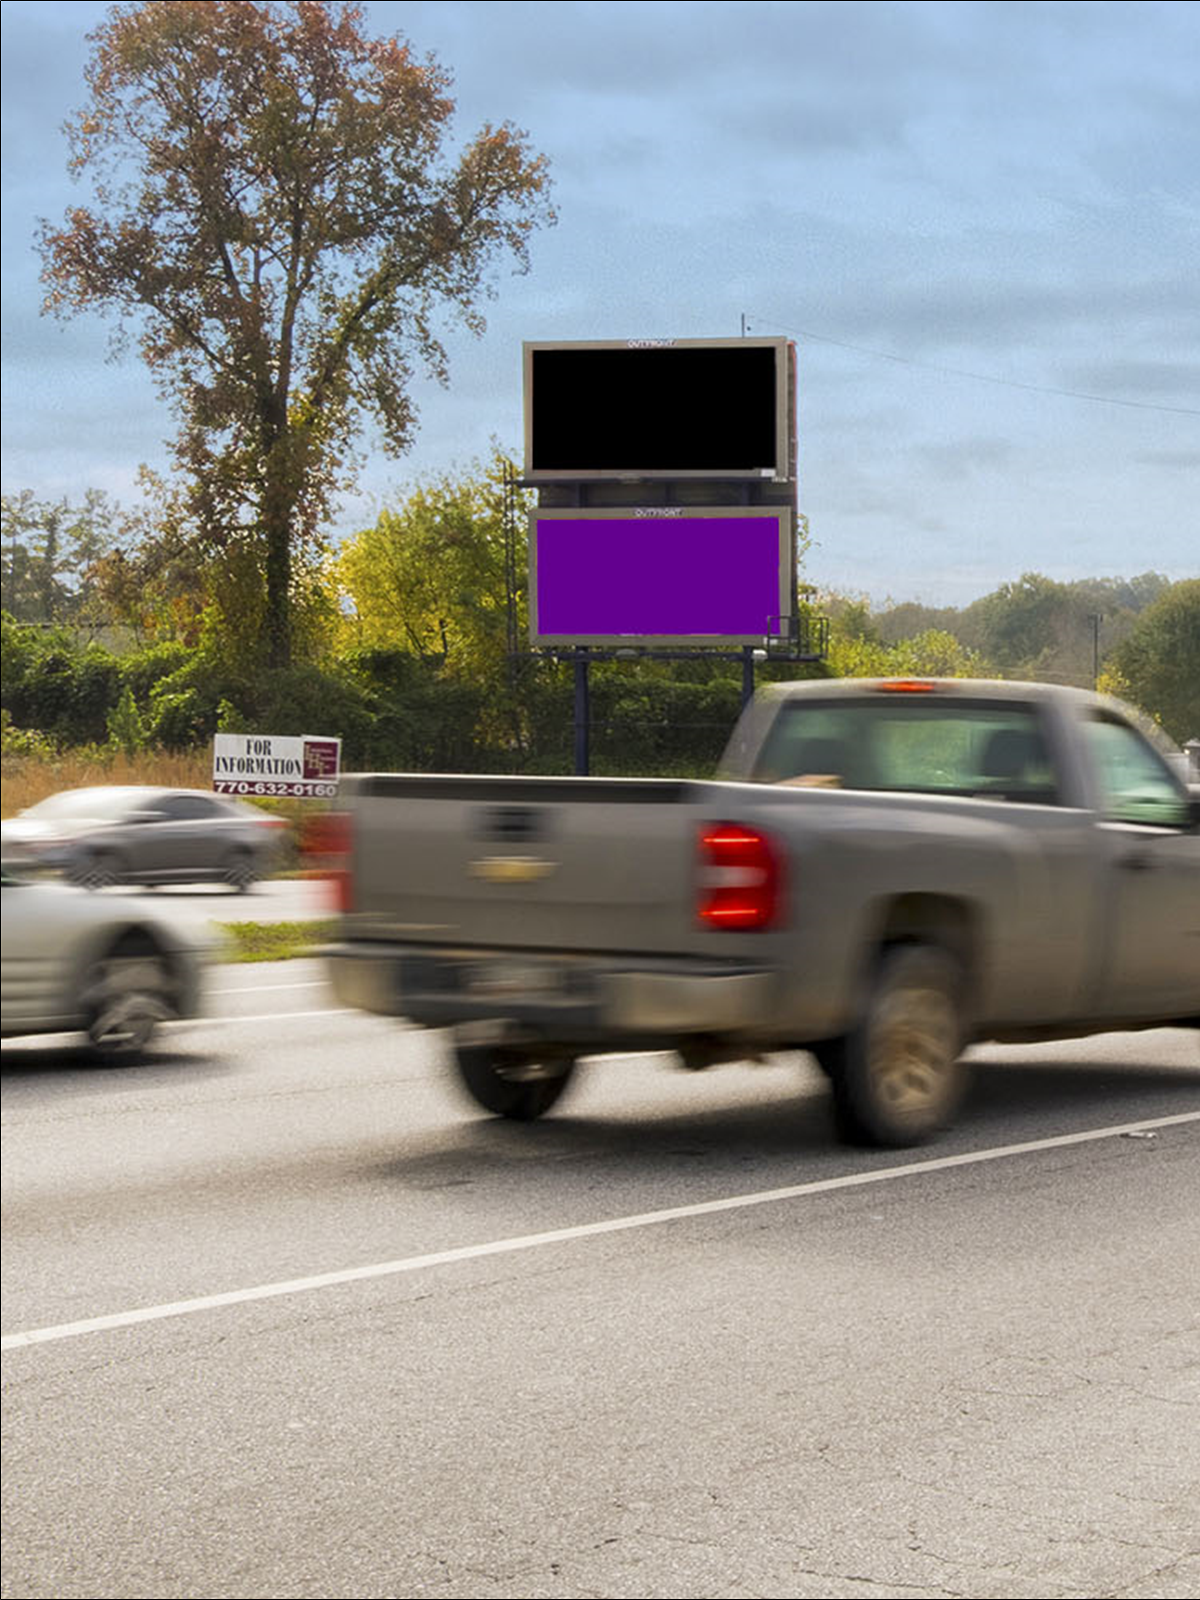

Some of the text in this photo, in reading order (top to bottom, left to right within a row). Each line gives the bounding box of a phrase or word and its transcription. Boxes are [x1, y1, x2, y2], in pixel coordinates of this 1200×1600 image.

[246, 739, 272, 756] FOR
[216, 756, 302, 775] INFORMATION
[215, 781, 337, 797] 770-632-0160
